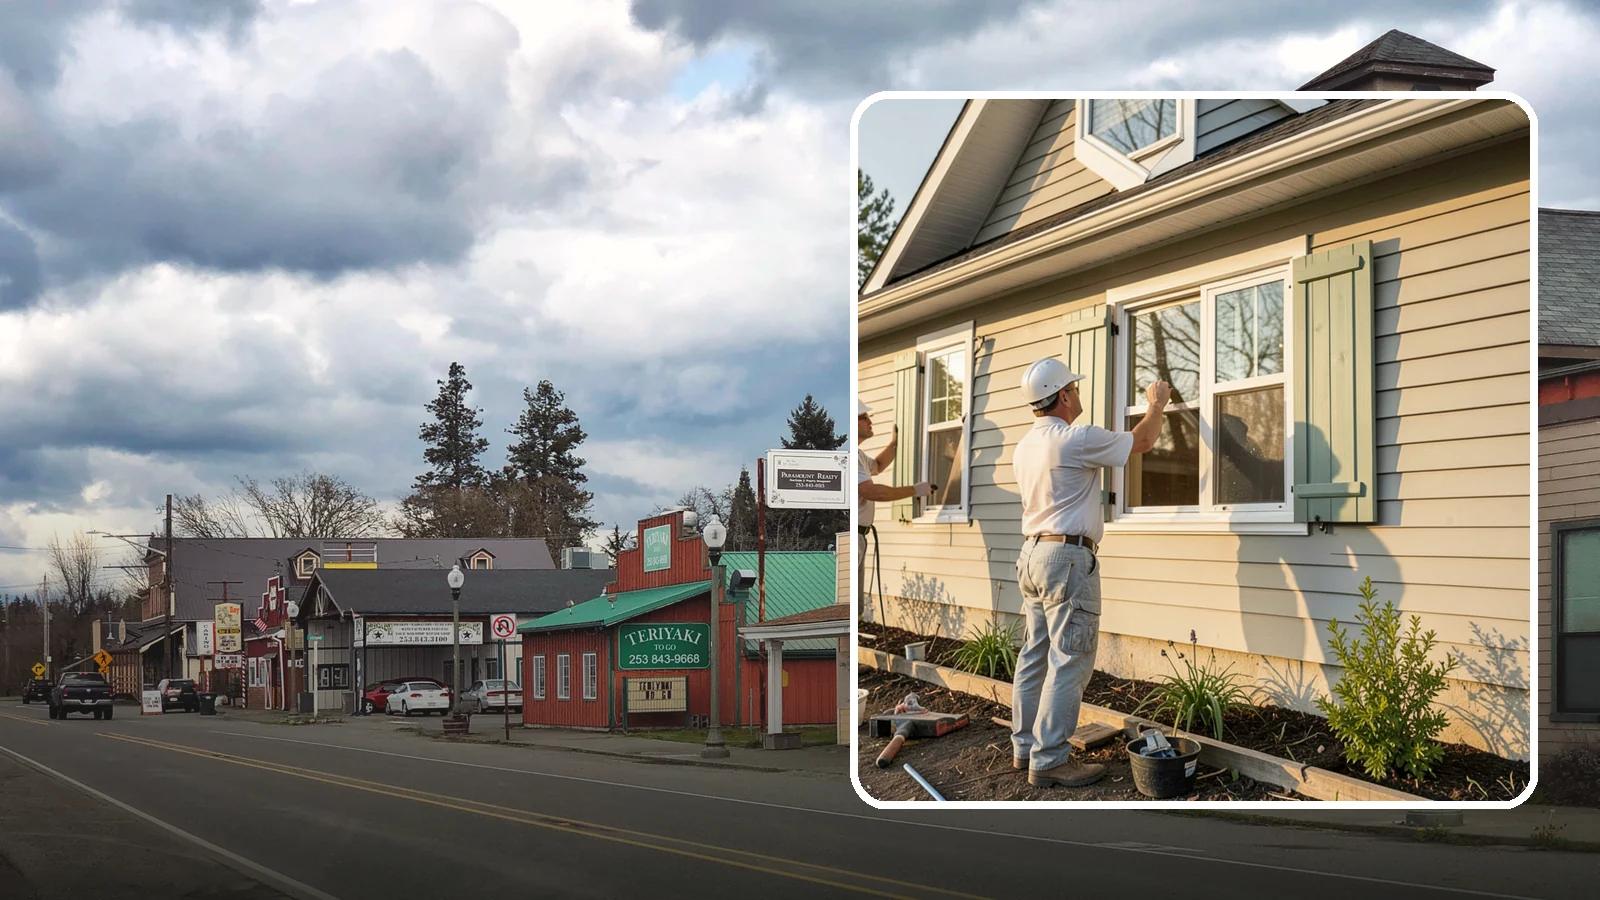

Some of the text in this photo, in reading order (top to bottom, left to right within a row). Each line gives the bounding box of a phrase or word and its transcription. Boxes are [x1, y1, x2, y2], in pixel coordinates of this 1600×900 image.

[625, 628, 702, 646] TERIYAKI
[629, 654, 700, 664] 253 843-9668
[639, 681, 672, 690] TERIYAKI
